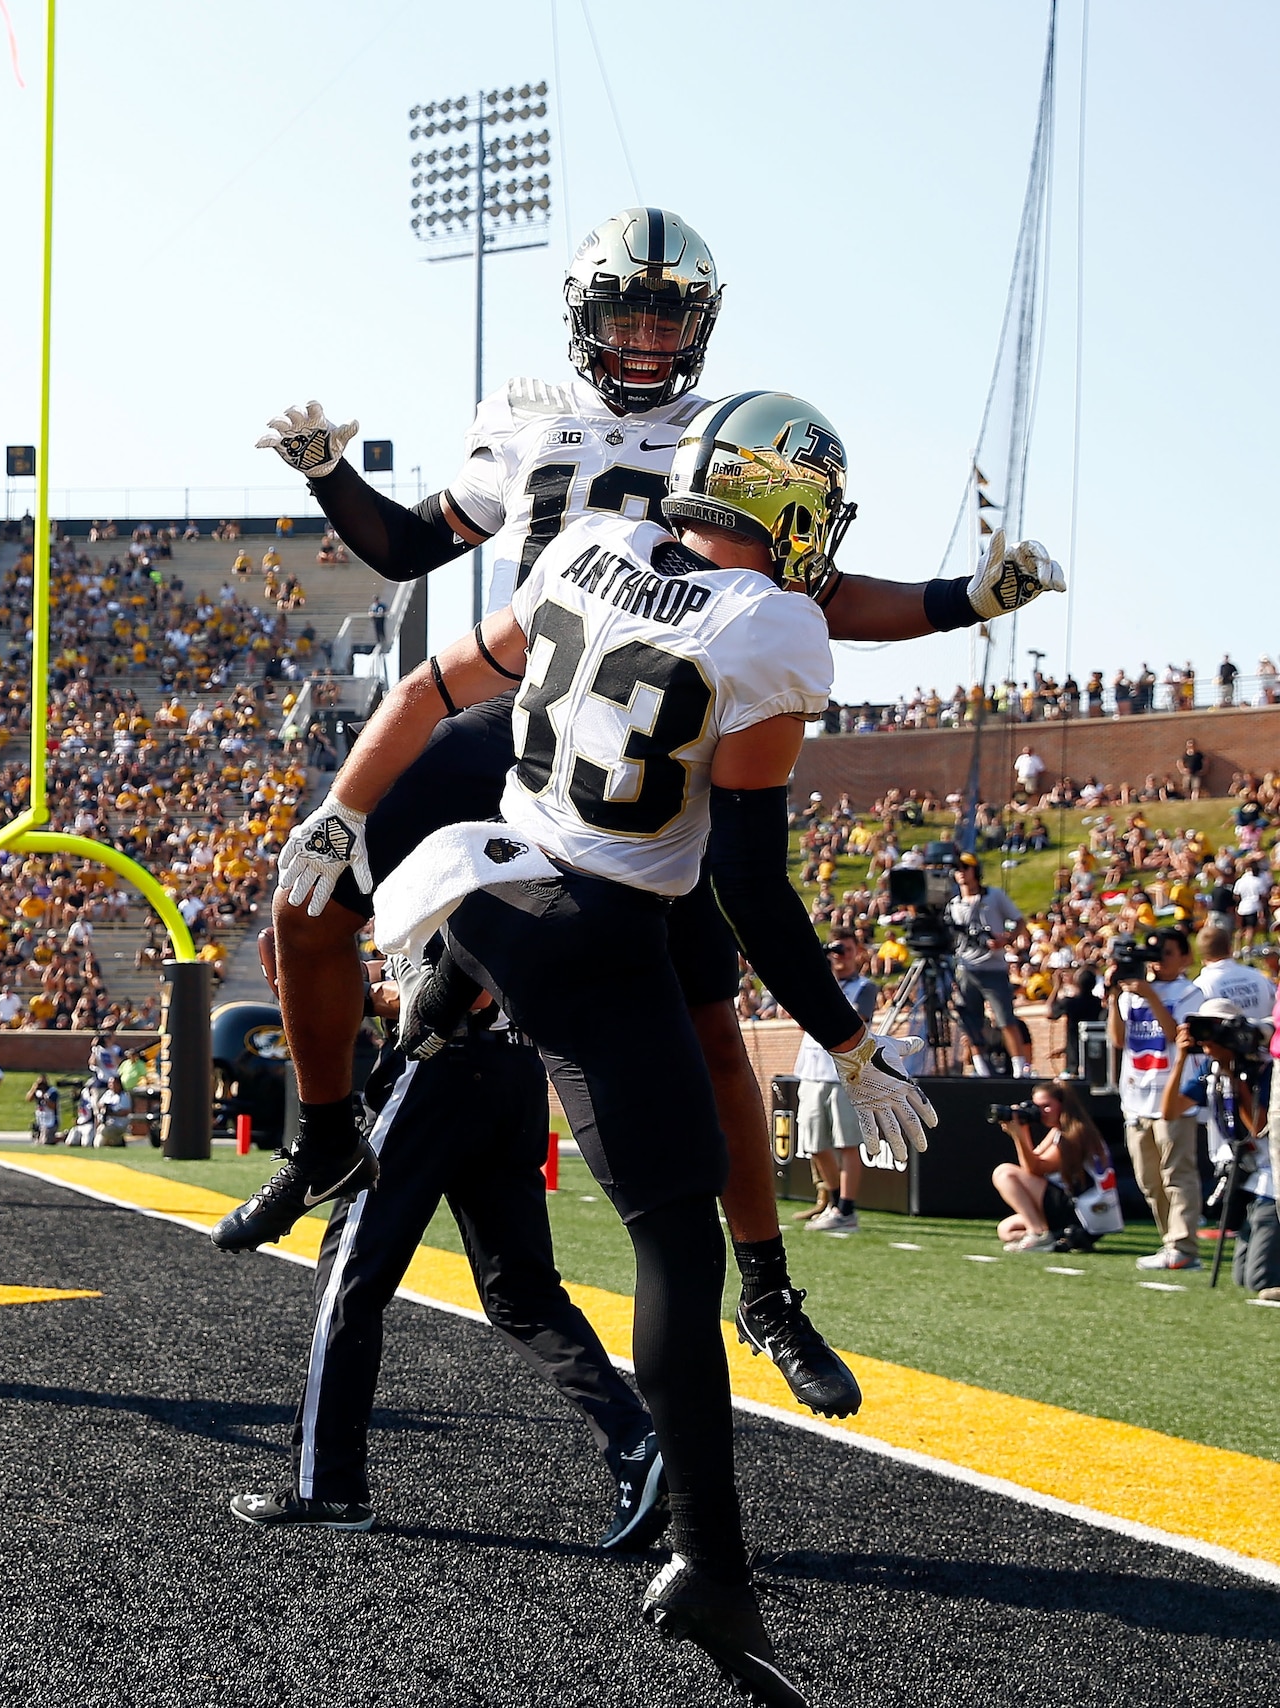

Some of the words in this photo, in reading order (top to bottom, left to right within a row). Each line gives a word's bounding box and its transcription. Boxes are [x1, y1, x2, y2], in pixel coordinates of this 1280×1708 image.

[298, 431, 328, 470] PURDUE
[561, 544, 711, 627] ANTHROP
[999, 562, 1019, 608] PURDUE
[514, 597, 717, 838] 33
[326, 818, 350, 862] PURDUE
